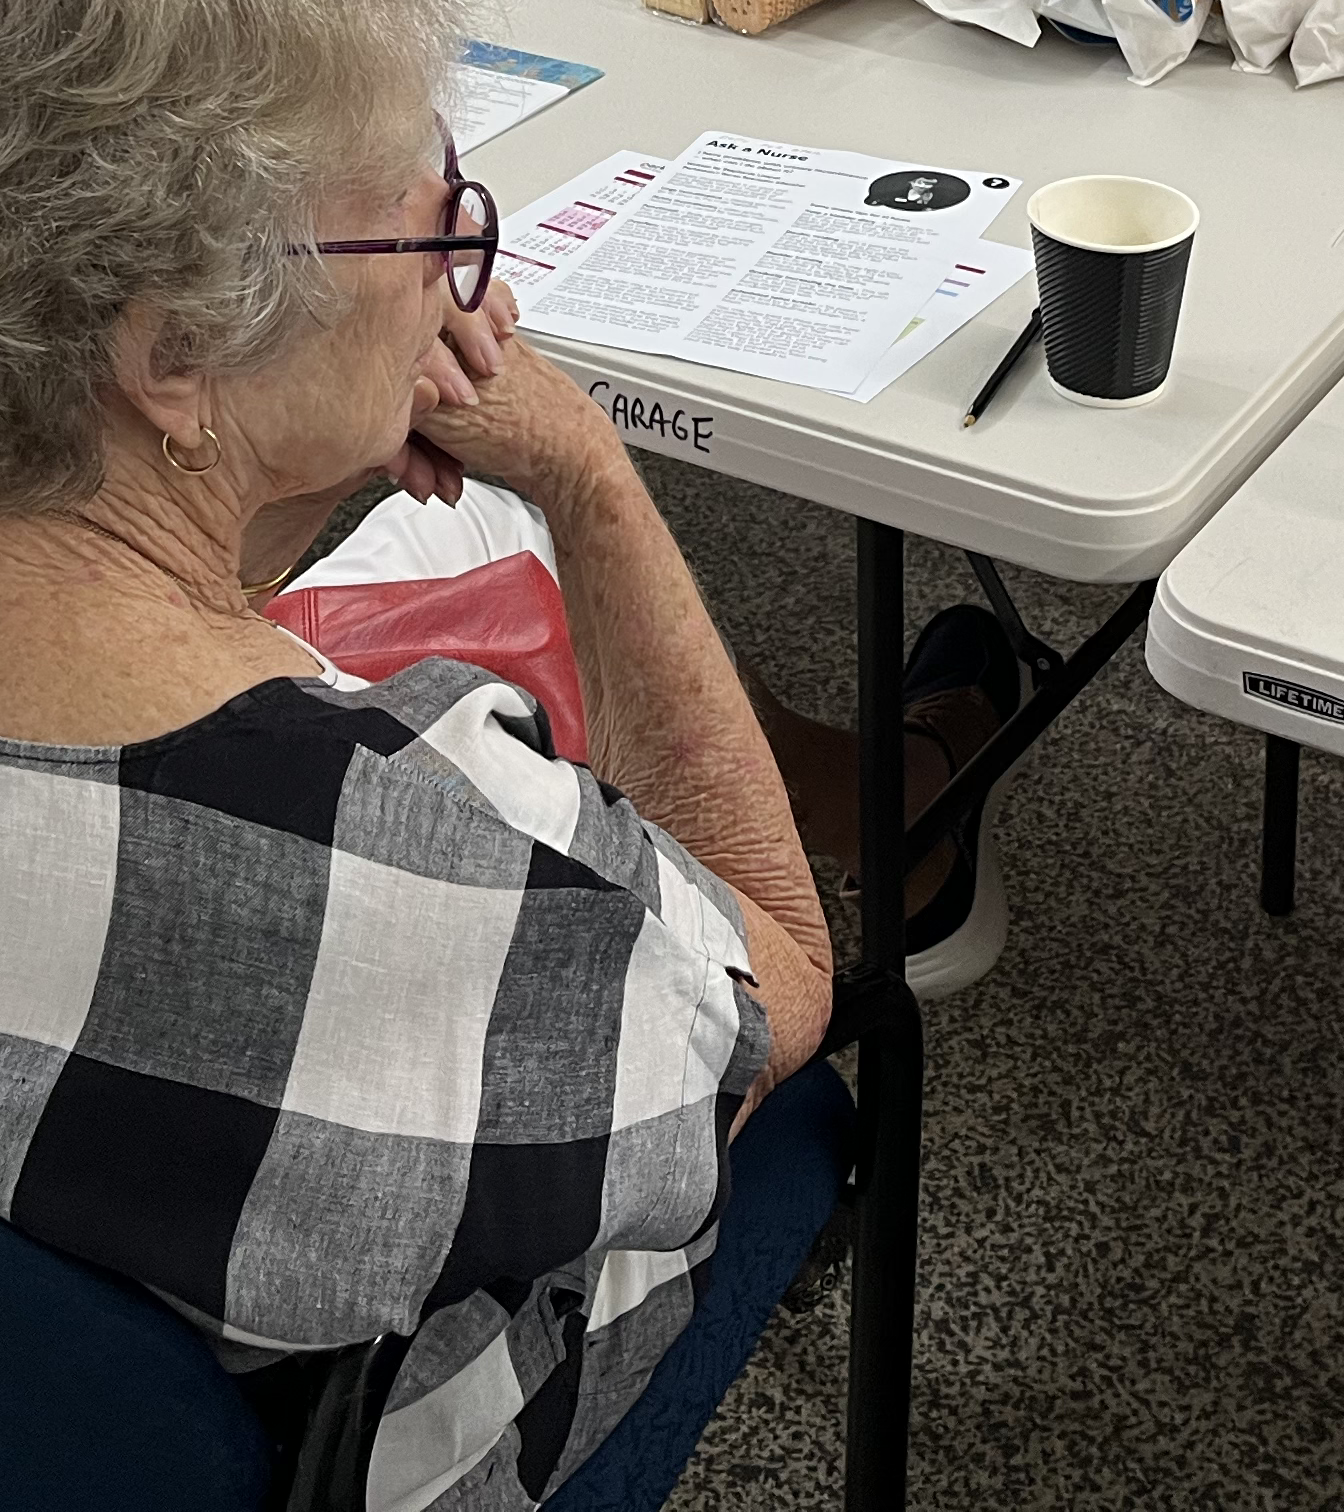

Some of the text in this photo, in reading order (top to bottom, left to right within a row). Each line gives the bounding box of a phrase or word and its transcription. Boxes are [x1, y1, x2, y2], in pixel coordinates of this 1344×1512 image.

[705, 139, 737, 151] Ask
[756, 147, 809, 162] Nurse
[1258, 680, 1344, 719] LIFETIME
